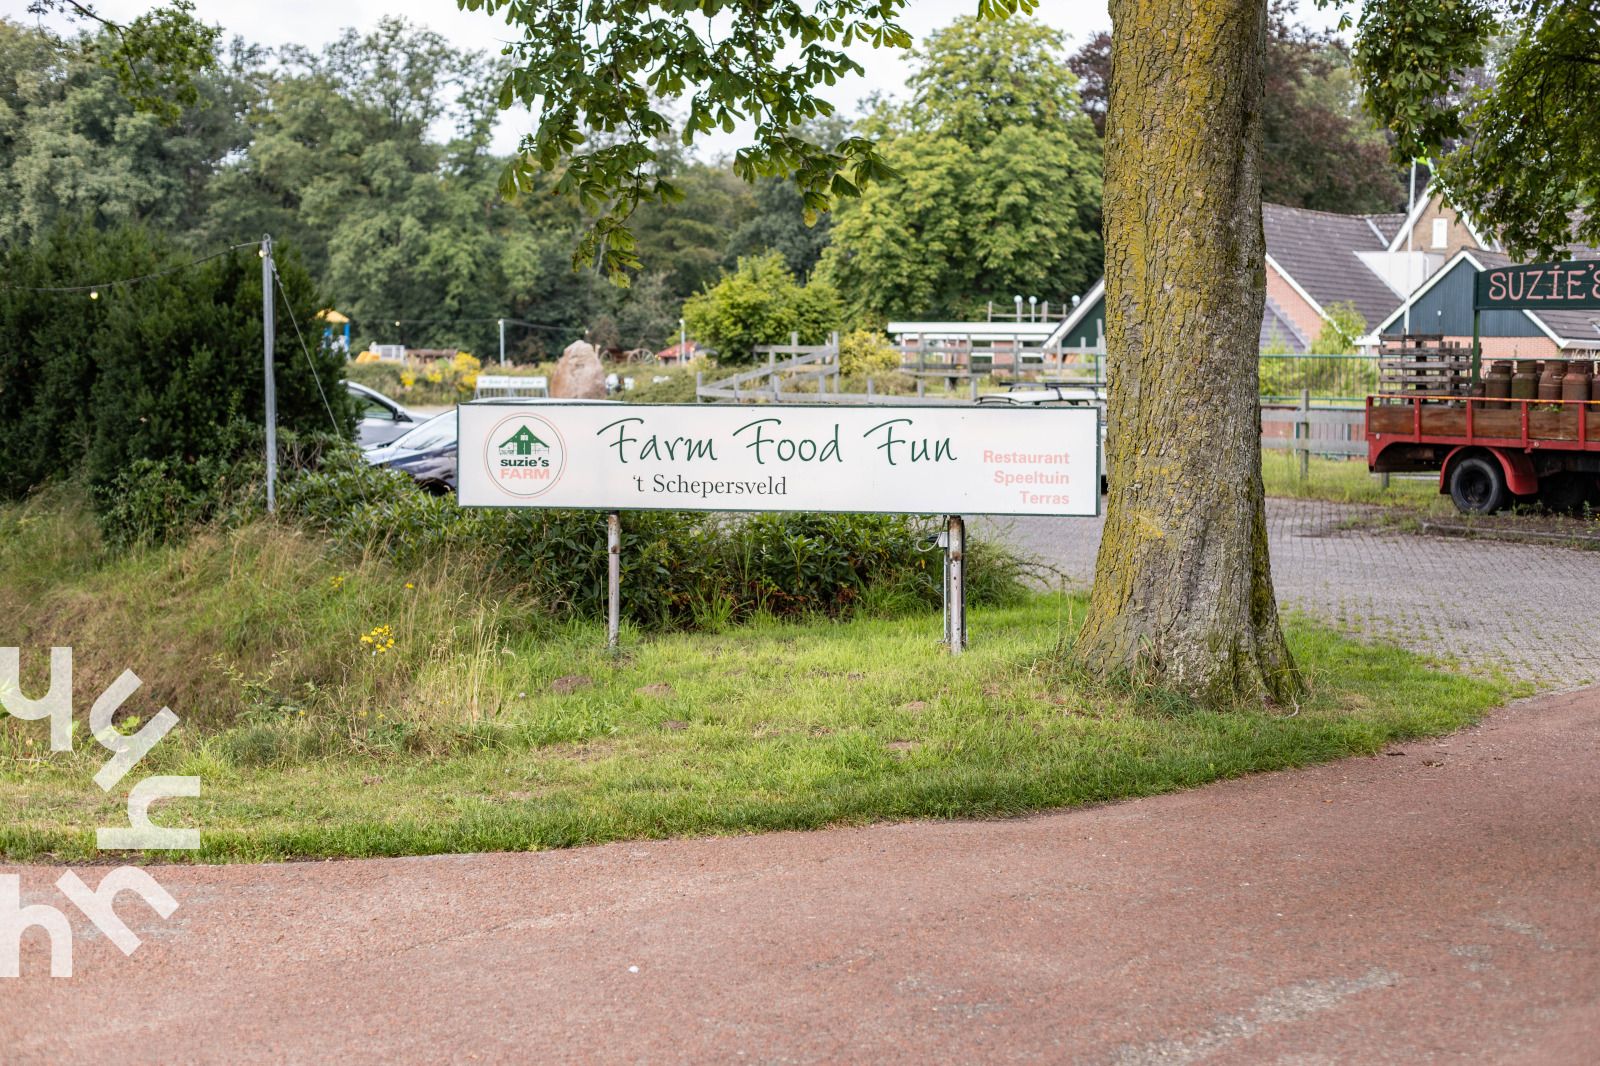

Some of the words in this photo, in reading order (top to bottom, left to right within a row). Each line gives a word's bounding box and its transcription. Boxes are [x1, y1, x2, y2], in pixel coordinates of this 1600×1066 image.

[596, 417, 719, 463] Farm
[732, 417, 843, 465] Food
[863, 418, 958, 466] Fun
[500, 456, 550, 467] suzie's
[983, 450, 1070, 465] Restaurant
[501, 468, 550, 480] FARM
[993, 470, 1070, 486] Speeltuin
[653, 473, 788, 498] Schepersveld
[1020, 491, 1070, 506] Terras
